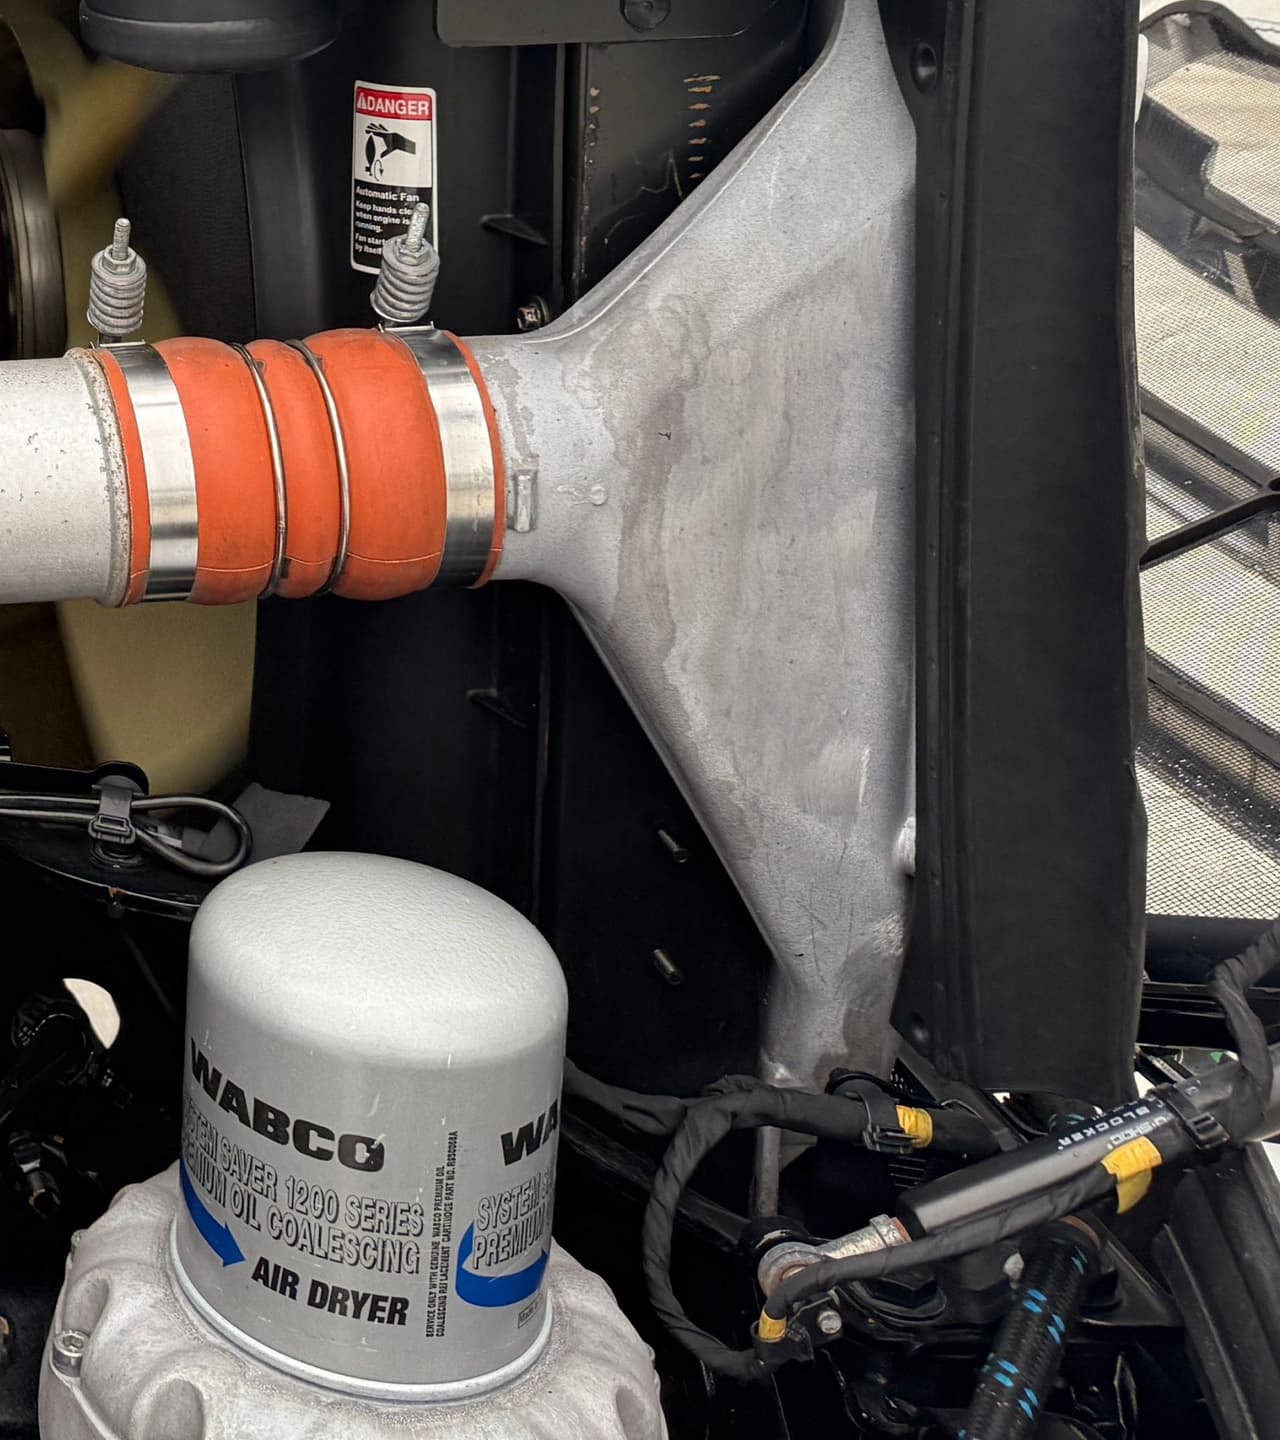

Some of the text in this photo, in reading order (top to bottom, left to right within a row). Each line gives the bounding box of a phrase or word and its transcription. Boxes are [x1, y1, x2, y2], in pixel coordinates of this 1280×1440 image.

[367, 95, 430, 116] DANGER
[355, 185, 420, 202] Automatic Fan
[355, 200, 372, 211] Keep
[372, 203, 397, 214] hands
[355, 211, 411, 225] when engine is
[355, 232, 367, 243] Fan
[191, 1037, 385, 1173] WABCO
[220, 1136, 278, 1203] SAVER
[285, 1175, 340, 1224] 1200
[344, 1194, 424, 1237] SERIES
[444, 1183, 455, 1200] PART
[230, 1182, 262, 1232] OIL
[266, 1205, 422, 1274] COALESCING
[441, 1201, 454, 1242] CARTRIDGE
[425, 1166, 445, 1338] SERVICE ONLY WITH GENUINE WABCO PREMIUM OIL
[438, 1246, 451, 1294] REPLACEMENT
[251, 1255, 410, 1327] AIR DRYER
[436, 1295, 448, 1337] COALESCING
